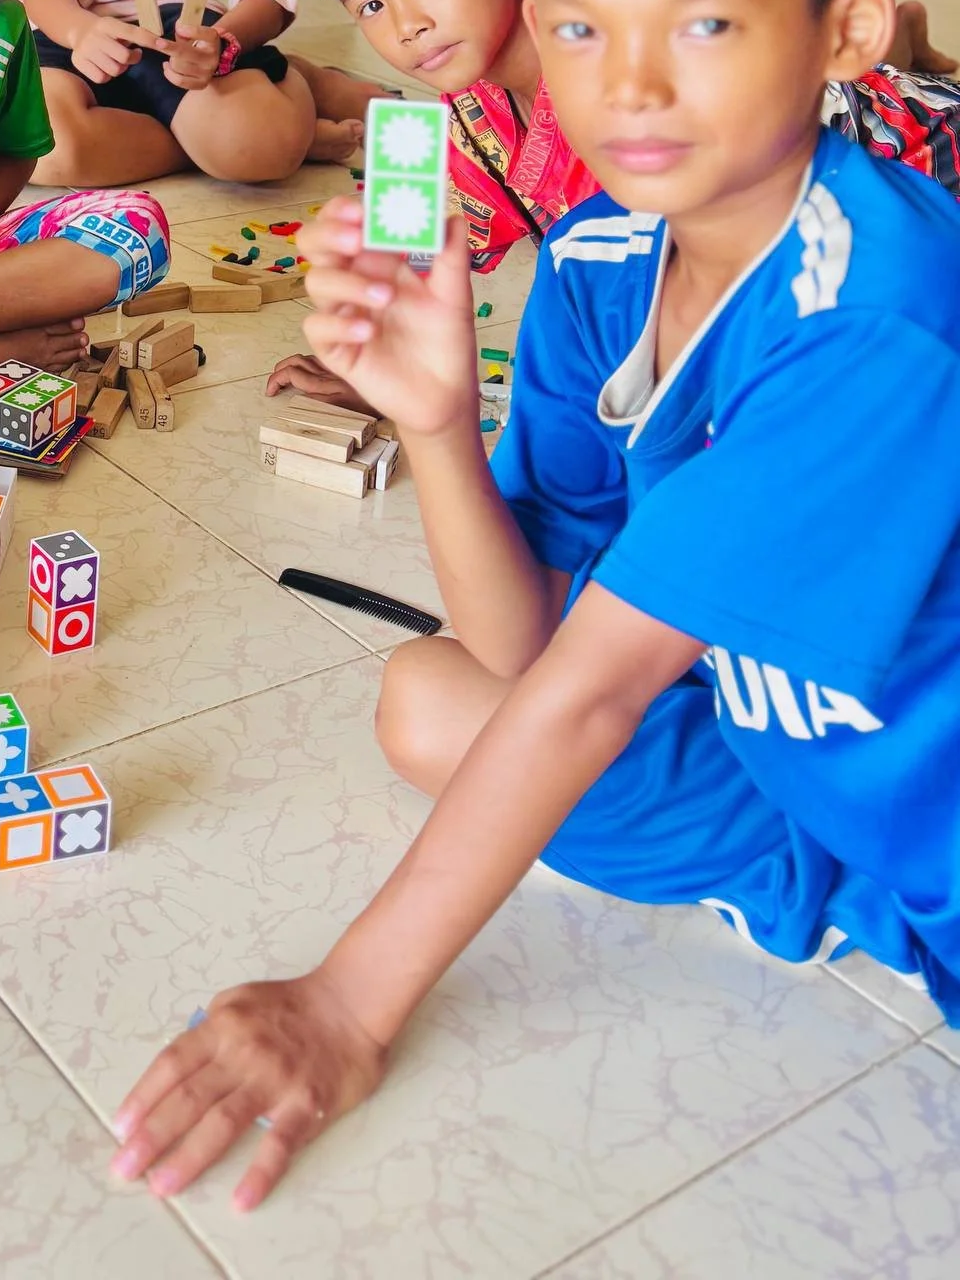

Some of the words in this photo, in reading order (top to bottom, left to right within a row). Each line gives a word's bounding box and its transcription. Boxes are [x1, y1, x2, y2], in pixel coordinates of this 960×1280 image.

[82, 215, 145, 253] BABY
[140, 408, 149, 421] 45
[158, 414, 168, 427] 48
[265, 451, 275, 466] 22
